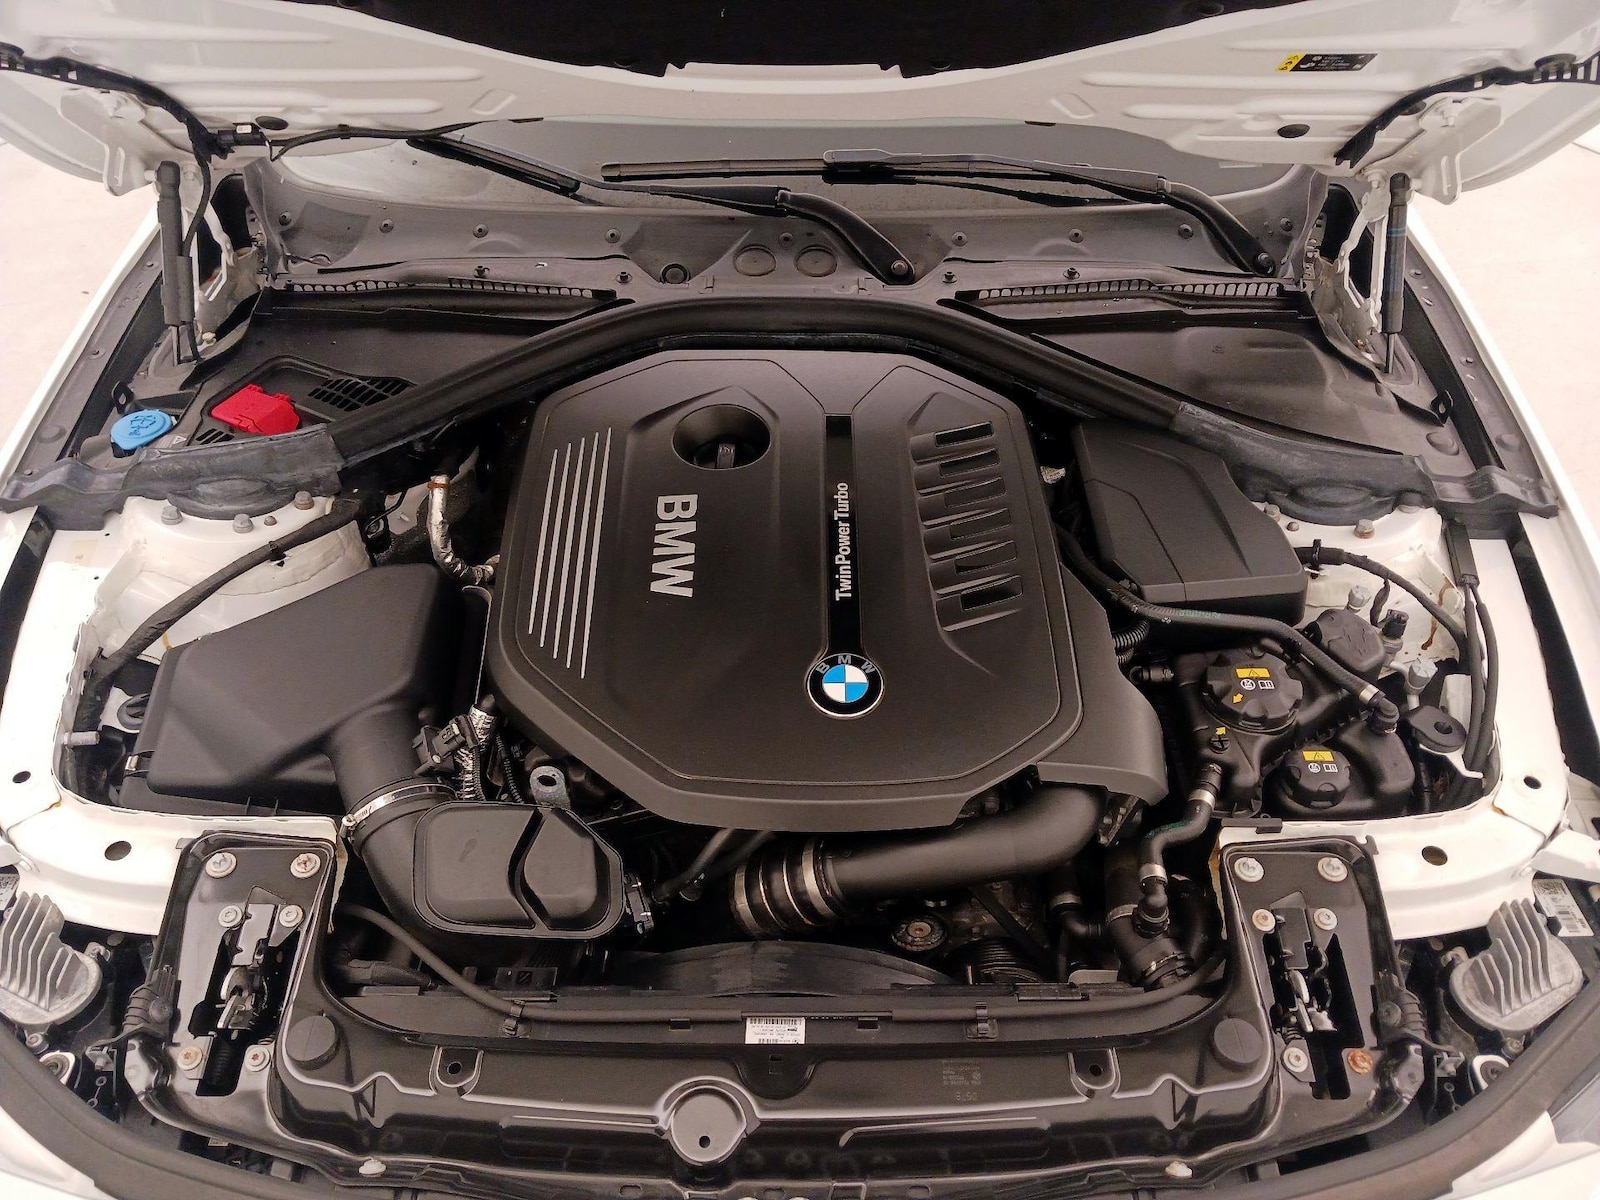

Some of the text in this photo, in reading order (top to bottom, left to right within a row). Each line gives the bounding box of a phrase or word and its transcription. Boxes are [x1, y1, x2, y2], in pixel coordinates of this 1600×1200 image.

[650, 494, 698, 598] BMW
[834, 482, 852, 601] TwinPower Turbo
[816, 655, 876, 675] BMW
